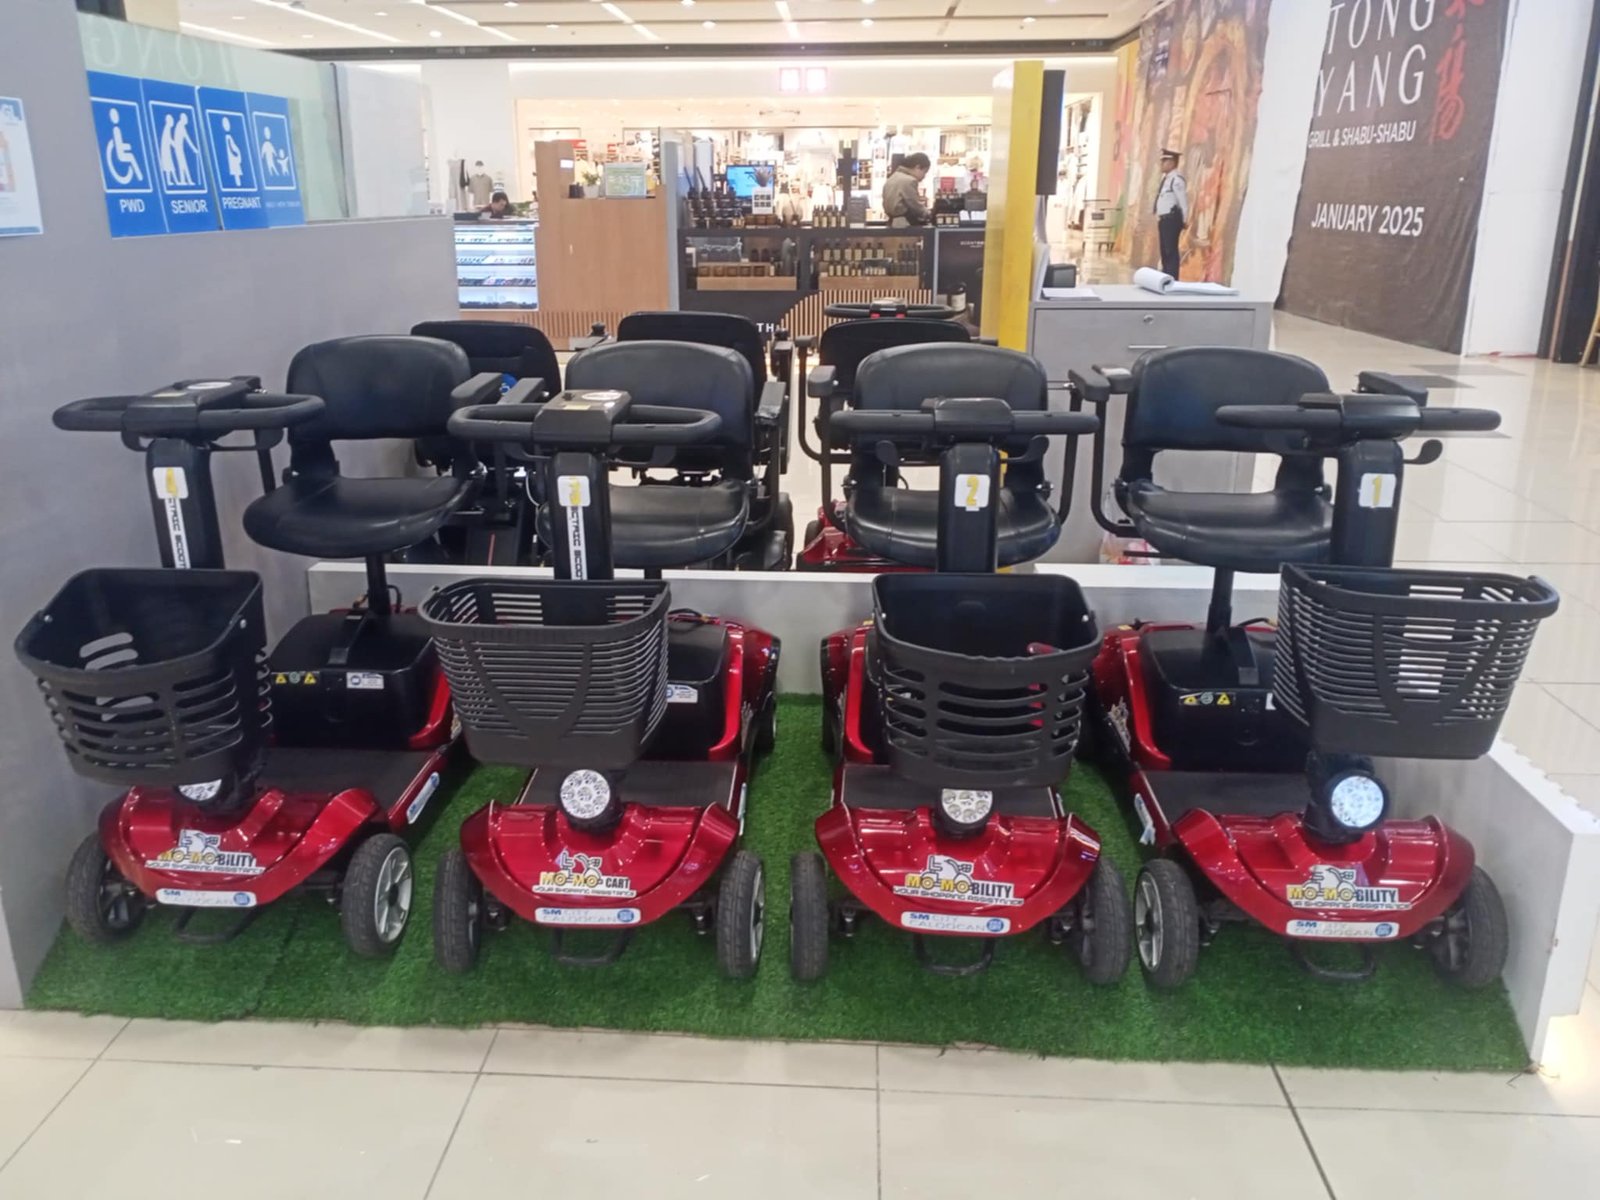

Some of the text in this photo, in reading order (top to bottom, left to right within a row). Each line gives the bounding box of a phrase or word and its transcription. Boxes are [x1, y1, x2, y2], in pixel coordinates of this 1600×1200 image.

[1328, 0, 1436, 54] TONG
[1317, 44, 1427, 117] YANG
[1308, 120, 1417, 149] GRILL & SHABU-SHABU
[119, 198, 146, 213] PWD
[170, 199, 208, 214] SENIOR
[221, 196, 262, 210] PREGNANT
[1311, 203, 1425, 237] JANUARY 2025
[756, 322, 774, 333] TH
[966, 475, 978, 506] 2
[1372, 475, 1382, 506] 1
[605, 877, 629, 889] CART
